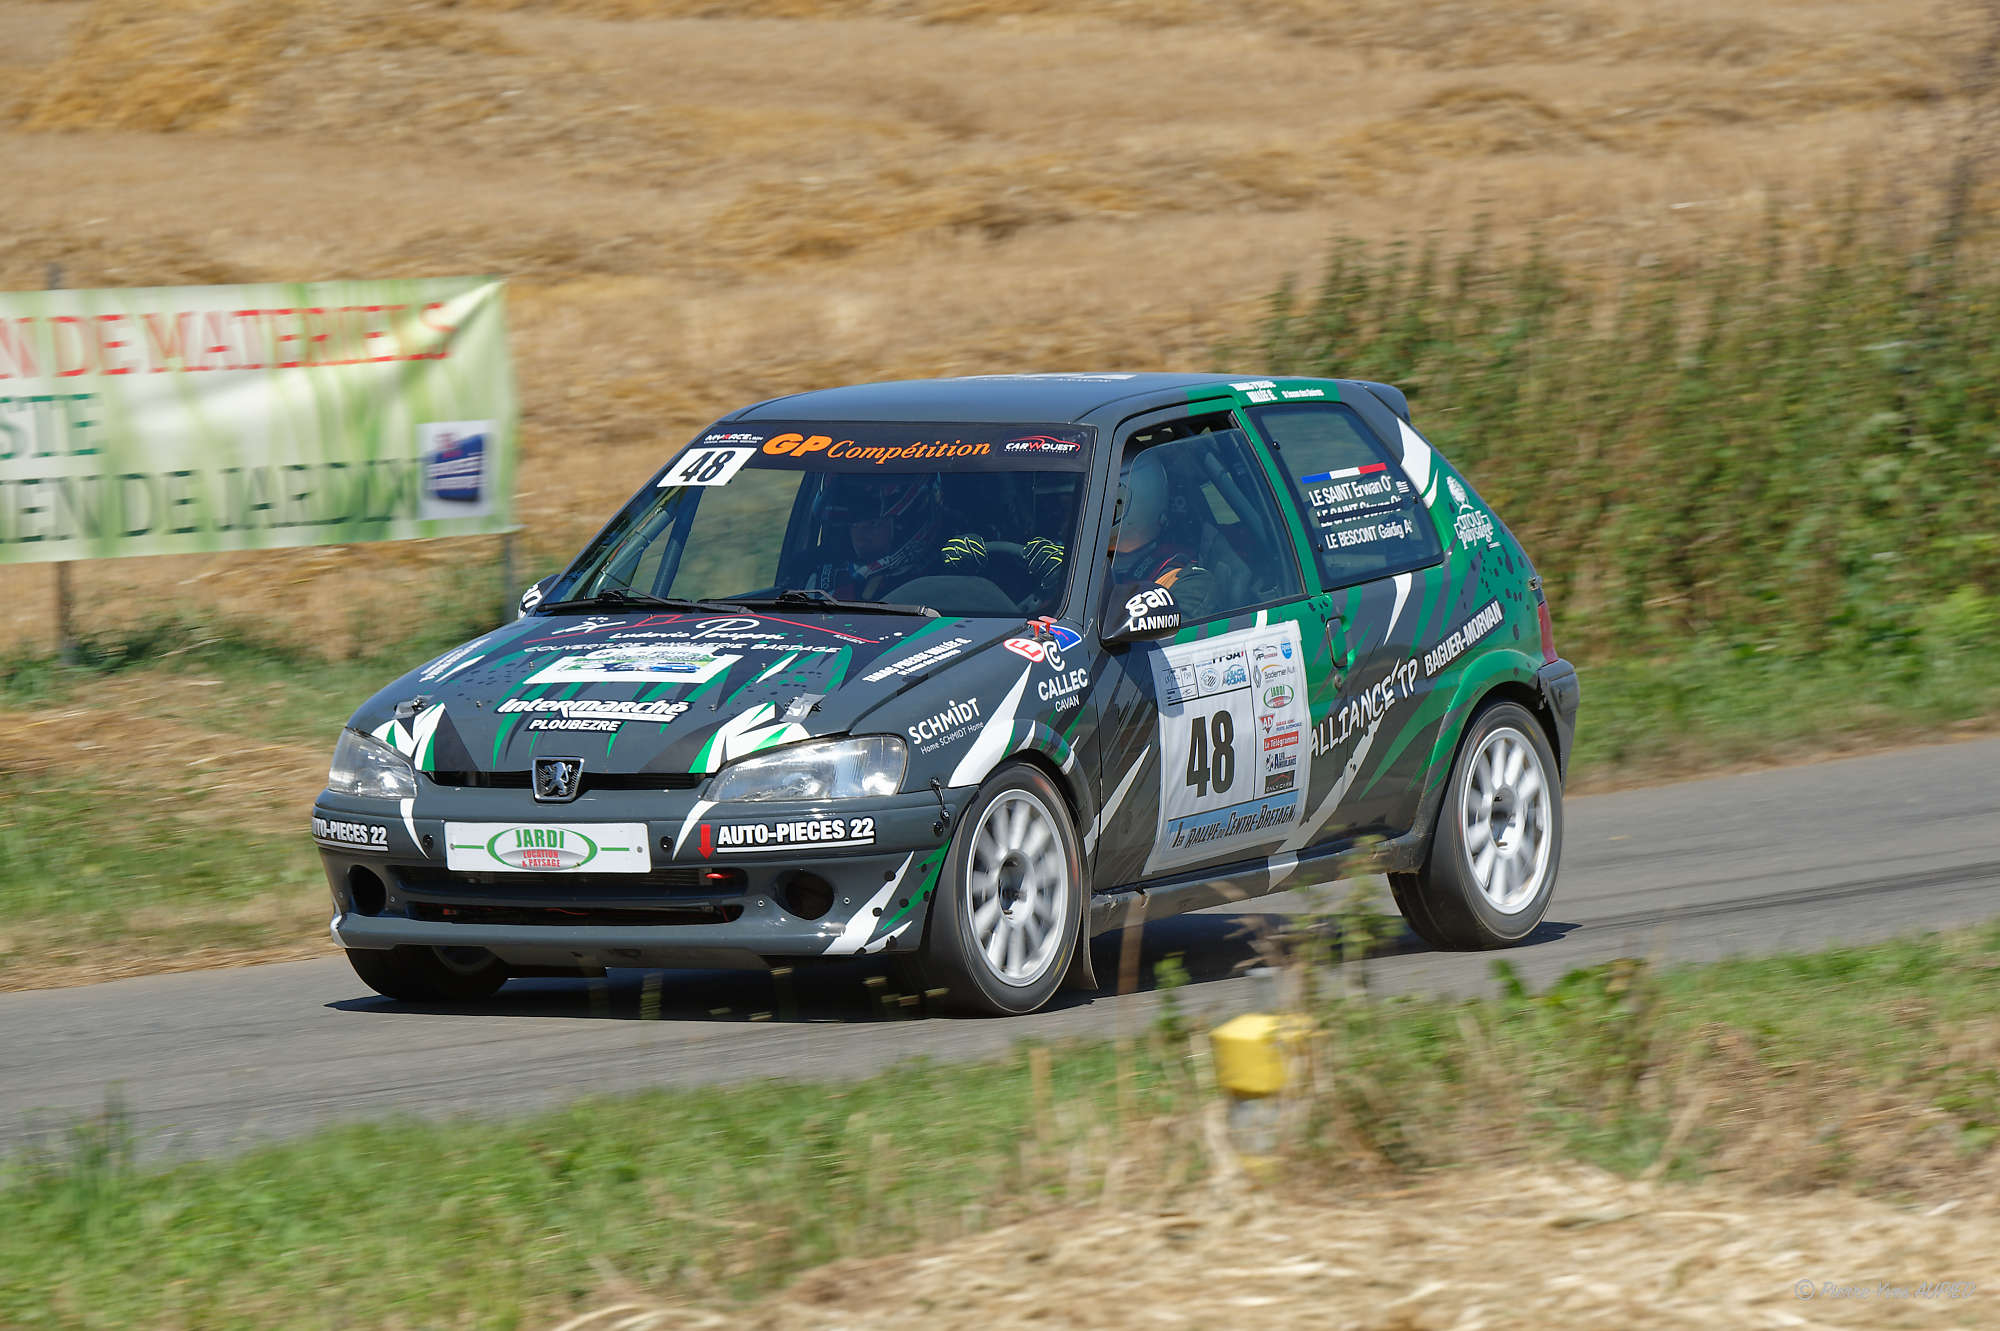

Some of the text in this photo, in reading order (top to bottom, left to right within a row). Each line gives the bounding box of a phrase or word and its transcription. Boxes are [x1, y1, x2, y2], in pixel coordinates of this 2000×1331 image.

[50, 313, 132, 378] DE
[762, 433, 991, 465] GP Compétition
[679, 450, 736, 482] 48
[116, 470, 202, 537] DE
[1308, 488, 1325, 507] LE
[1322, 482, 1353, 504] SAINT
[1351, 480, 1383, 497] Erwan
[1325, 533, 1339, 549] LE
[1337, 526, 1378, 548] BESCONT
[1125, 587, 1174, 617] gan
[1128, 613, 1180, 632] LANNION
[750, 643, 842, 653] BARDAGE
[1424, 600, 1503, 677] BAGUER-MORVAN
[1038, 667, 1089, 701] CALLEC
[497, 697, 690, 717] Intermarché
[1055, 695, 1080, 713] CAVAN
[529, 719, 622, 732] PLOUBEZRE
[920, 720, 984, 755] Home SCHMIDT Home
[1186, 710, 1235, 797] 48
[370, 826, 388, 845] 22
[515, 828, 564, 848] JARDI
[718, 817, 875, 846] AUTO-PIECES 22
